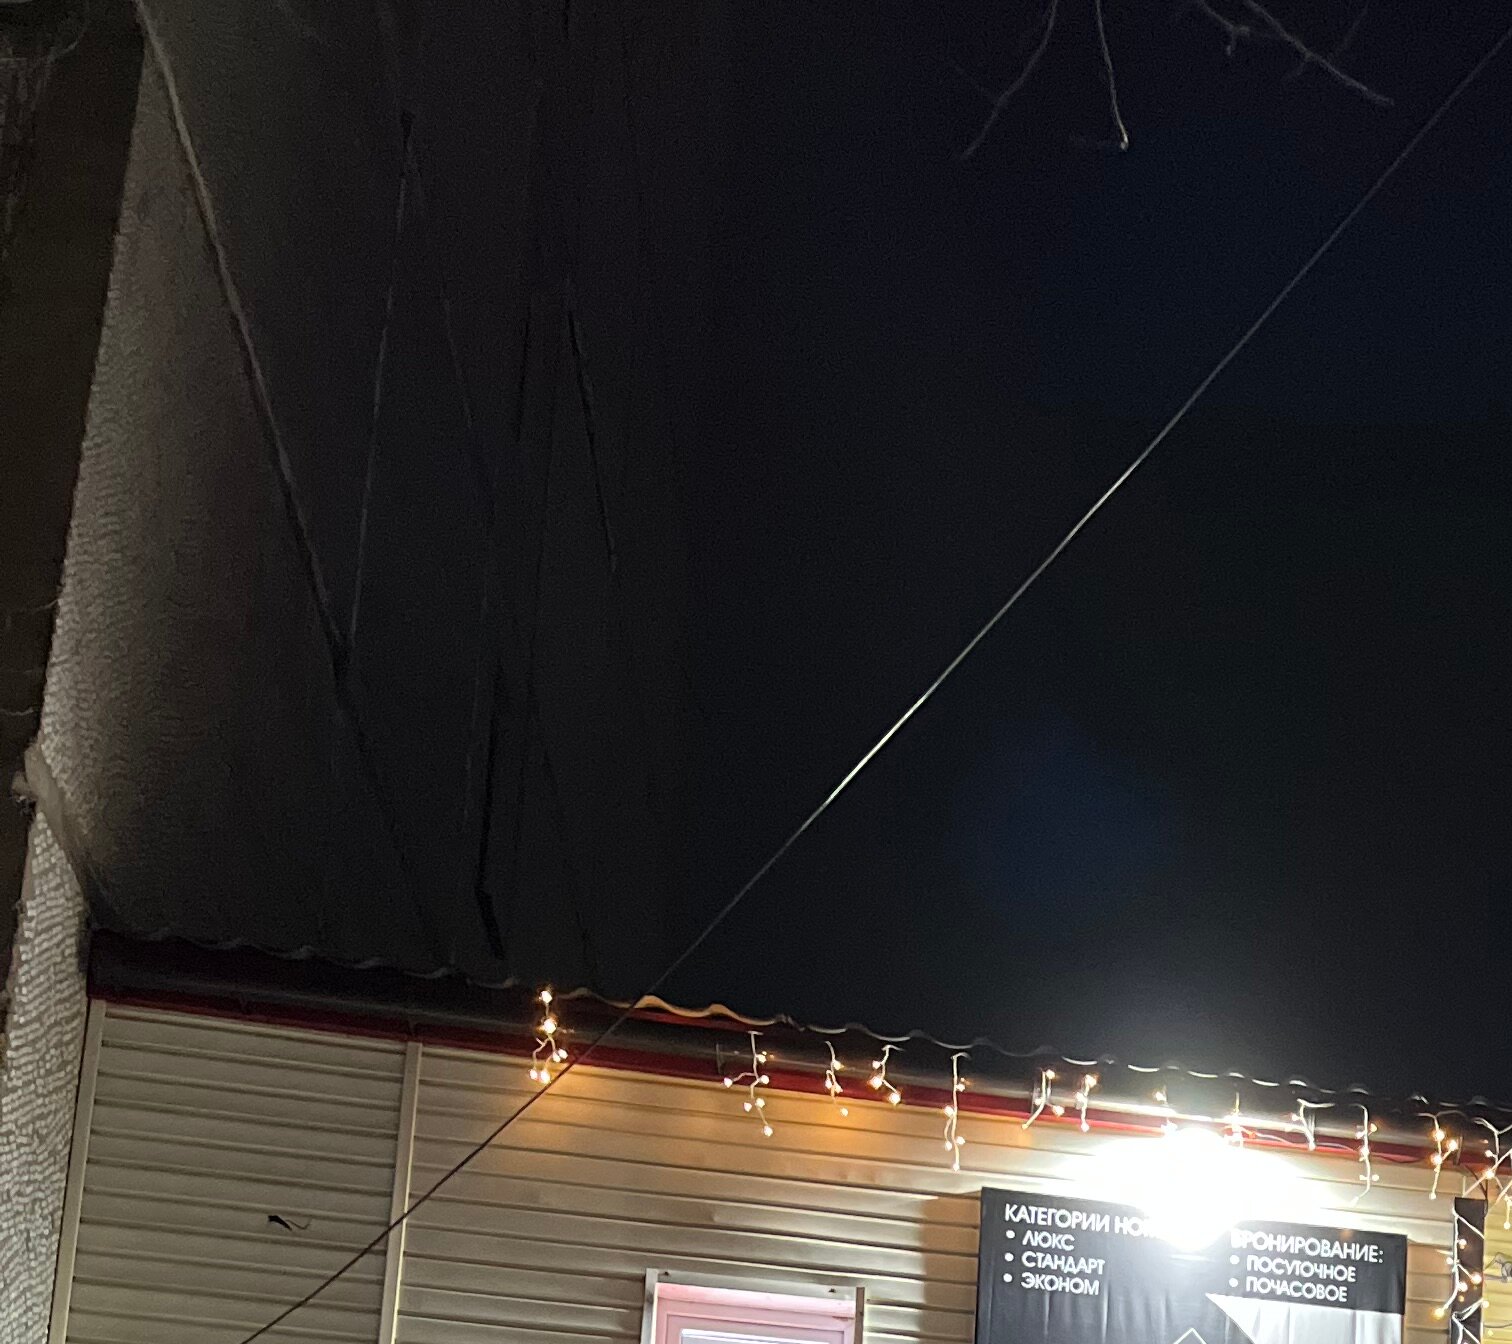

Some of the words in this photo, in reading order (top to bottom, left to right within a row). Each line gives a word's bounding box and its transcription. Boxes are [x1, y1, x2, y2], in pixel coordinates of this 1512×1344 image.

[1004, 1203, 1110, 1232] КАТЕГОРИИ
[1022, 1230, 1076, 1251] ЛЮКС
[1020, 1251, 1106, 1275] СТАНДАРТ
[1246, 1254, 1357, 1282] ПОСУТОЧНОЕ
[1020, 1271, 1100, 1296] ЭКОНОМ
[1245, 1276, 1348, 1302] ПОЧАСОВОЕ
